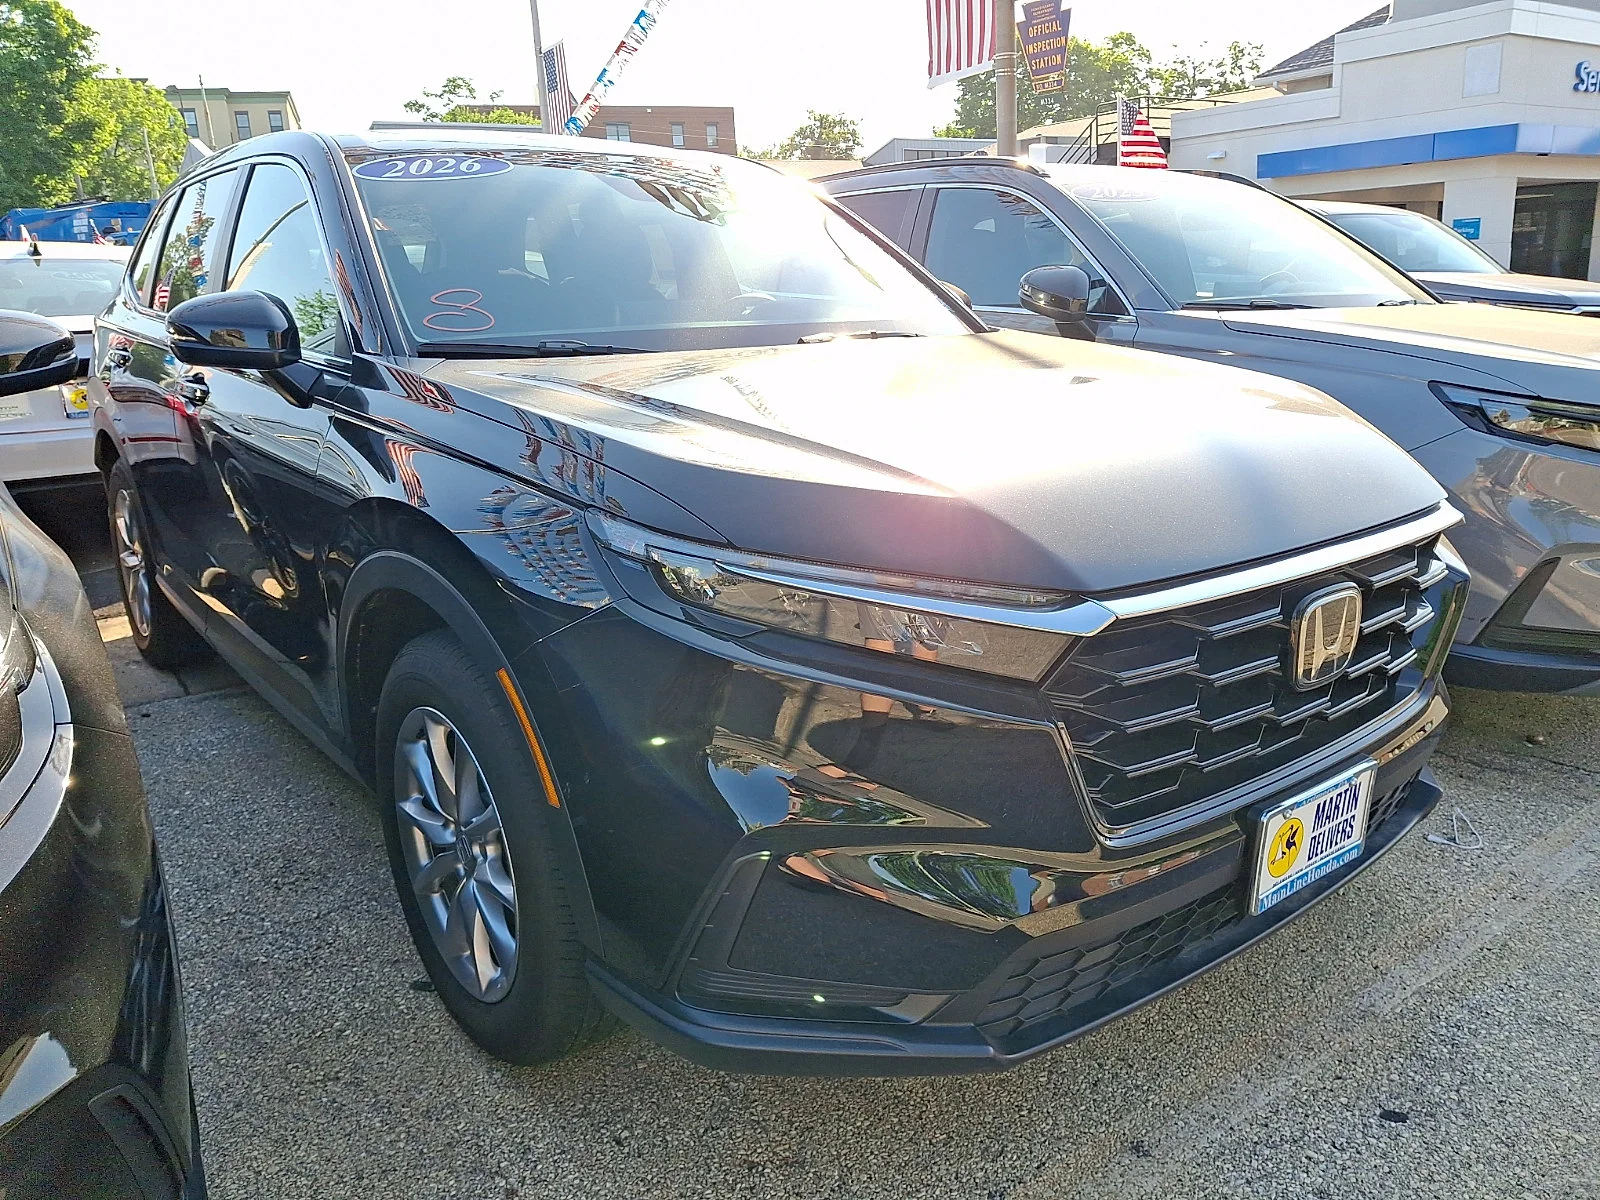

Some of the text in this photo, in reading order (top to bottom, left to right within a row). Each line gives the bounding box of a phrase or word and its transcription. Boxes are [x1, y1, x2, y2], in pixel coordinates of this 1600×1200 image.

[1029, 20, 1062, 37] OFFICIAL
[1026, 36, 1066, 54] INSPECTION
[1032, 54, 1062, 70] STATION
[381, 157, 482, 178] 2026
[1312, 781, 1362, 833] MARTIN
[1307, 815, 1356, 862] DELIVERS
[1260, 847, 1358, 911] MainLineHonda.com
